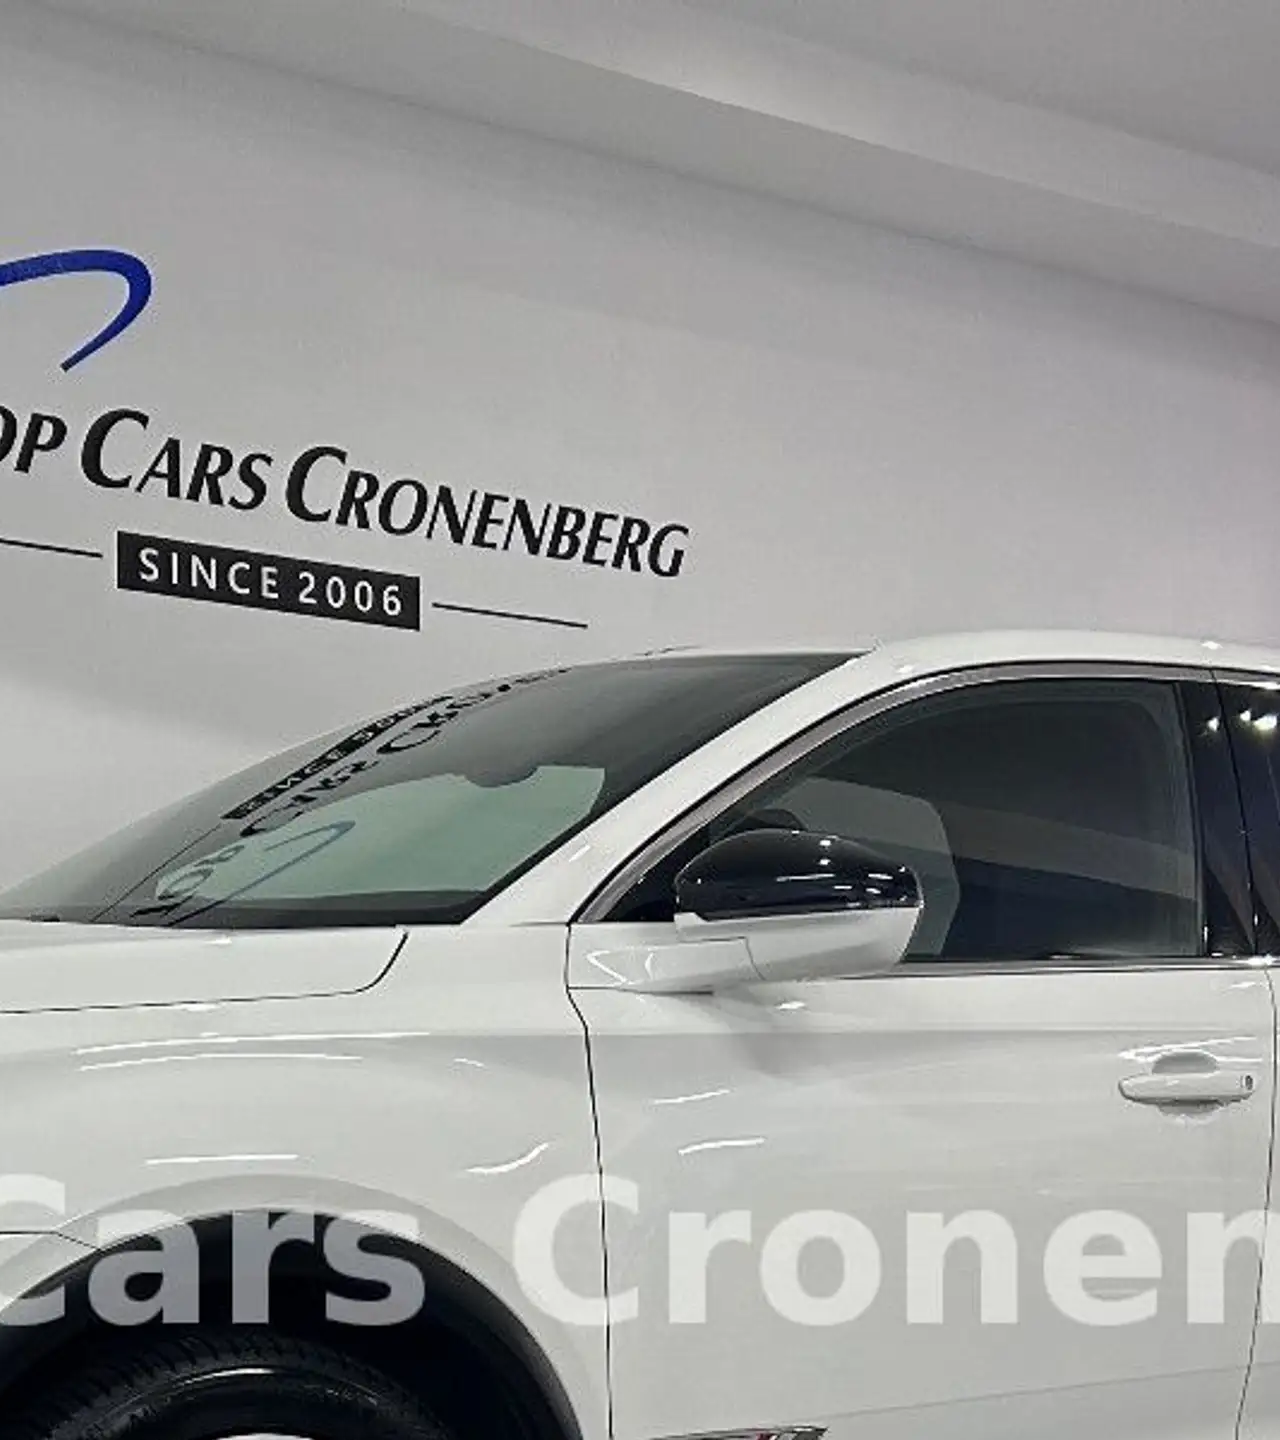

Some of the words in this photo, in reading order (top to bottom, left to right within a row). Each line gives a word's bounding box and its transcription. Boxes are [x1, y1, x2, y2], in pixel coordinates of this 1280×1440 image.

[81, 408, 274, 511] CARS
[285, 446, 689, 578] CRONENBERG
[138, 546, 280, 600] SINCE
[297, 570, 403, 617] 2006
